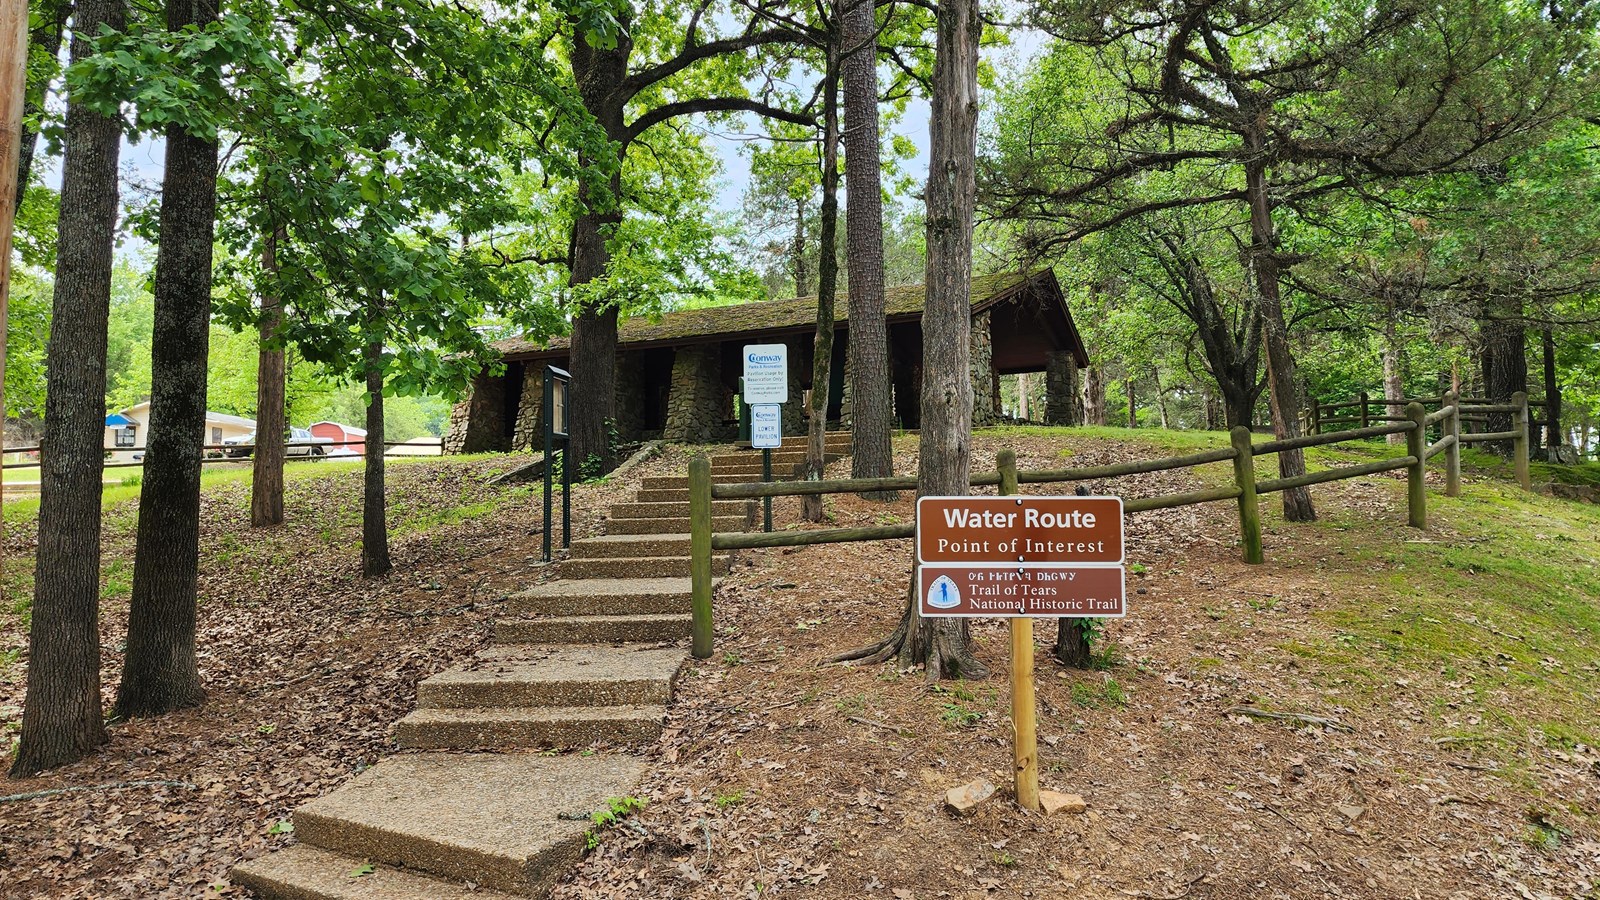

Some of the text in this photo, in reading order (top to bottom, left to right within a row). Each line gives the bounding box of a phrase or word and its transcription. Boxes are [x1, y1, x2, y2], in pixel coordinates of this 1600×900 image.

[748, 353, 782, 364] Conway
[755, 411, 776, 419] Conway
[943, 508, 1096, 528] Water Route
[938, 538, 1105, 553] Point of Interest
[968, 584, 1057, 595] Trail of Tears
[969, 598, 1025, 609] National
[1030, 598, 1083, 609] Historic
[1086, 598, 1118, 609] Trail
